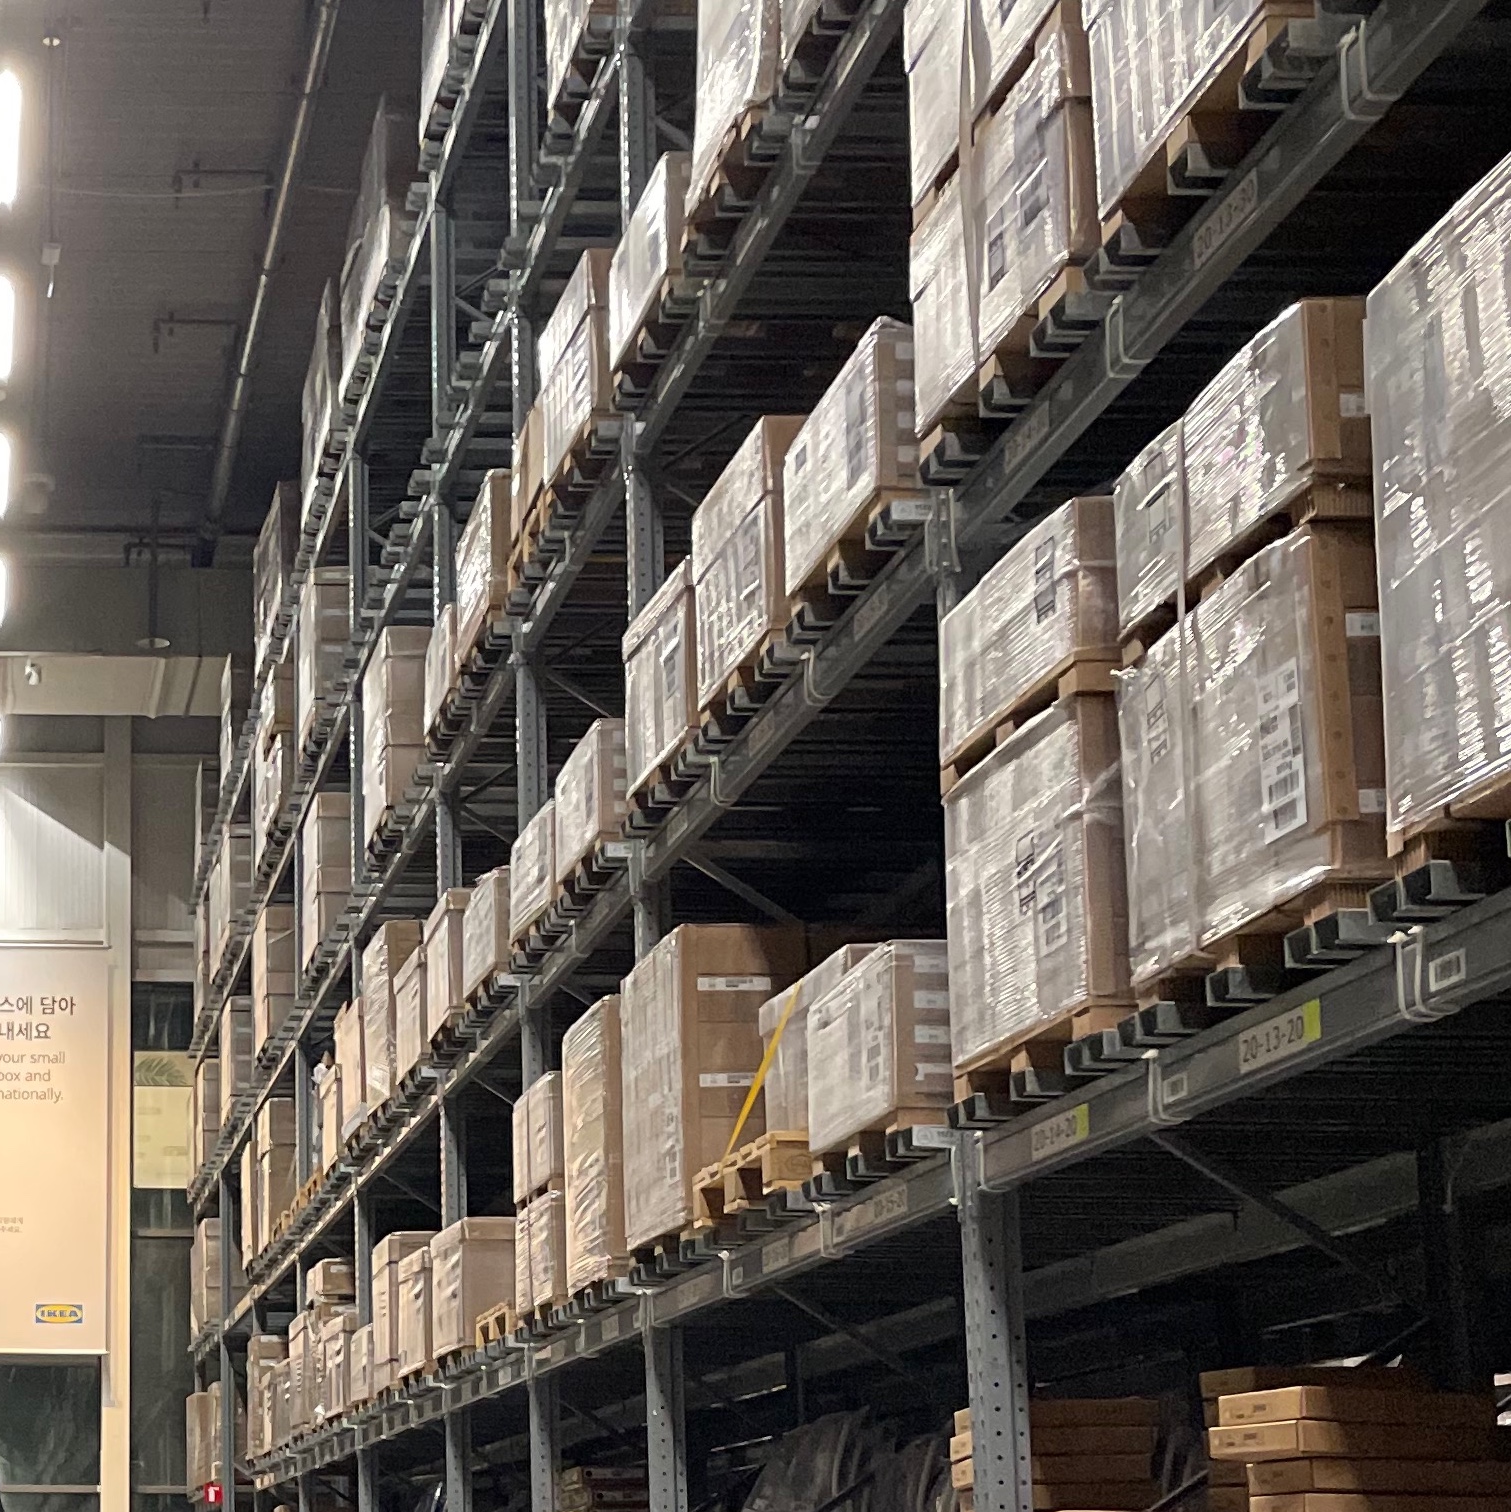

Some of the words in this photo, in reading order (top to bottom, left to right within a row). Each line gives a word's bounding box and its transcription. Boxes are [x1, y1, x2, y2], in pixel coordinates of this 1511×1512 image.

[40, 996, 76, 1016] 담아
[1242, 1016, 1304, 1063] 20-13-20
[30, 1051, 65, 1064] small
[25, 1069, 51, 1082] and
[41, 1309, 78, 1317] IKEA
